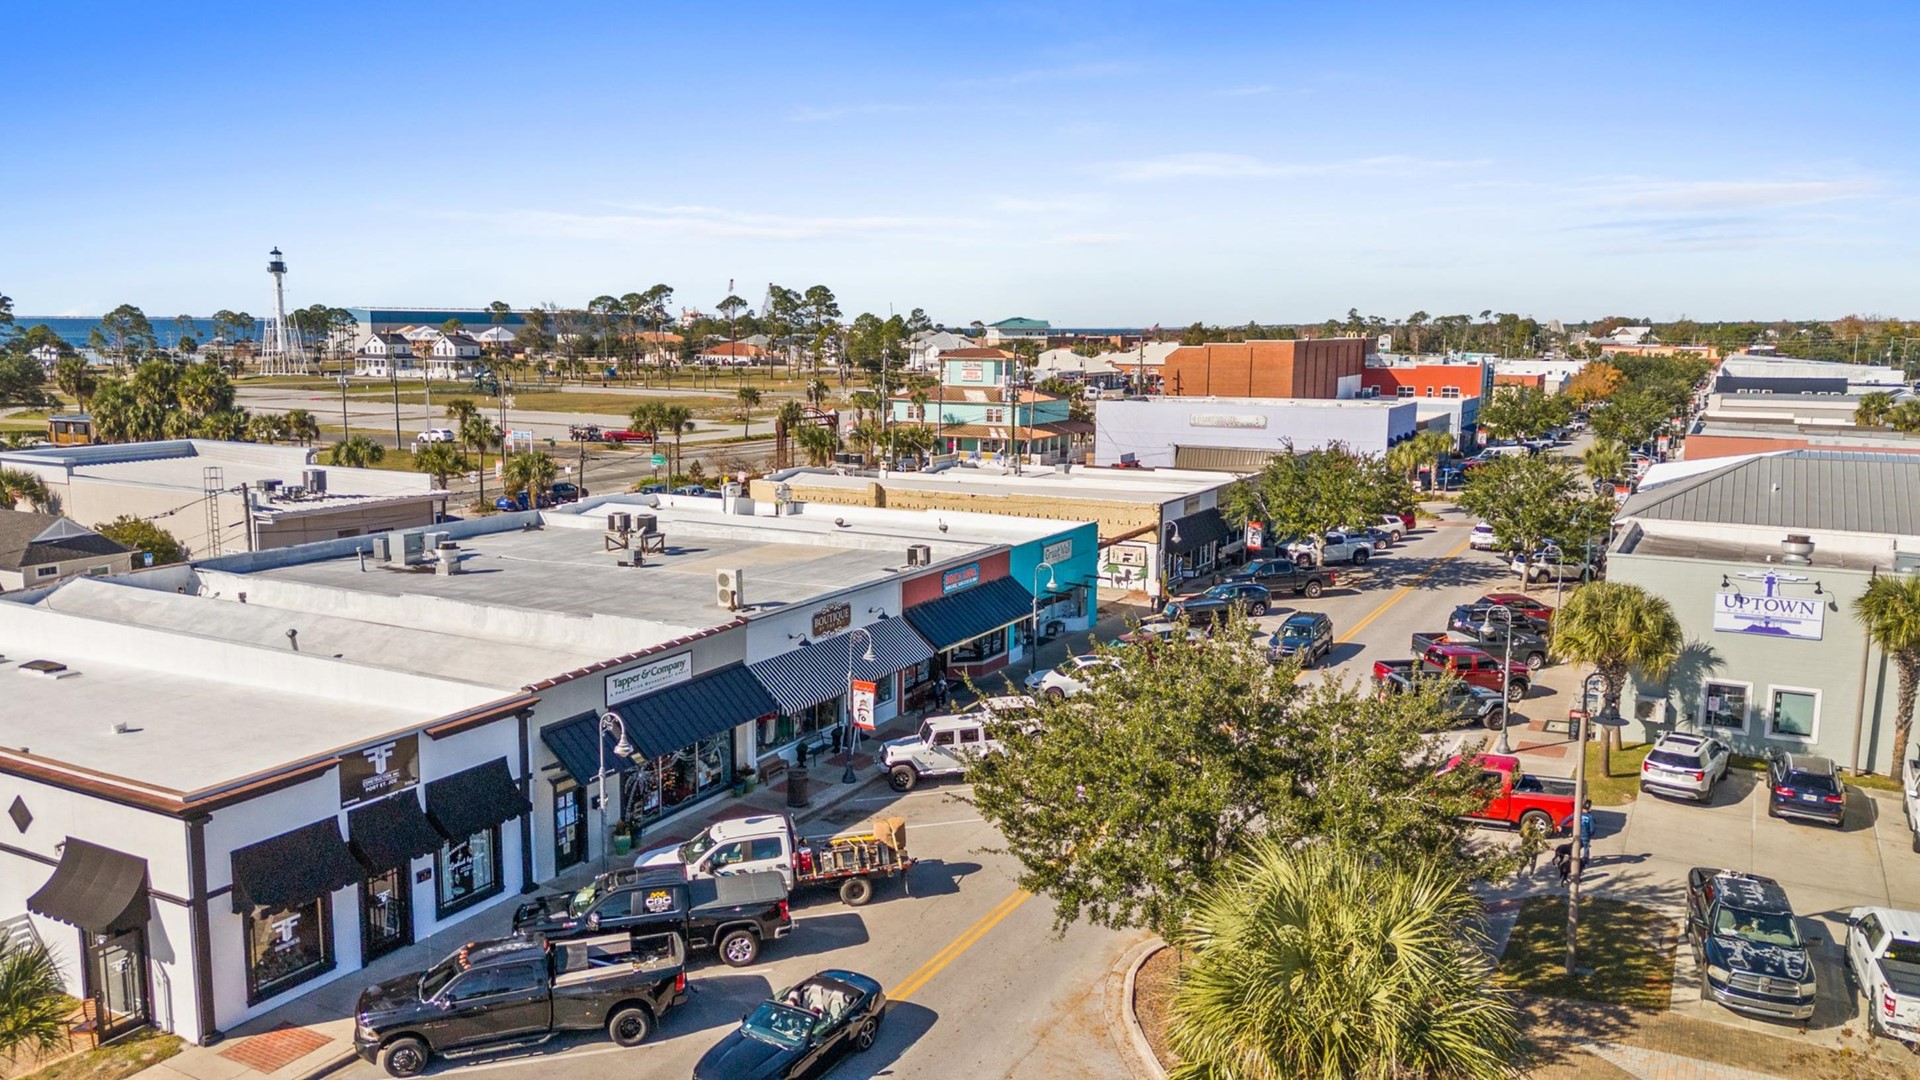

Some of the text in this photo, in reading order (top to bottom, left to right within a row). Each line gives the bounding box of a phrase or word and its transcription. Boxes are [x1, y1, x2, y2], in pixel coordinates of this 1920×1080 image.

[1724, 596, 1815, 615] UPTOWN
[814, 608, 849, 628] BOUTIQUE
[612, 659, 686, 690] Tapper & Company
[363, 774, 391, 788] CONSTRUCTION
[365, 784, 379, 792] PORT
[388, 778, 397, 786] JOE
[646, 896, 671, 906] CBC
